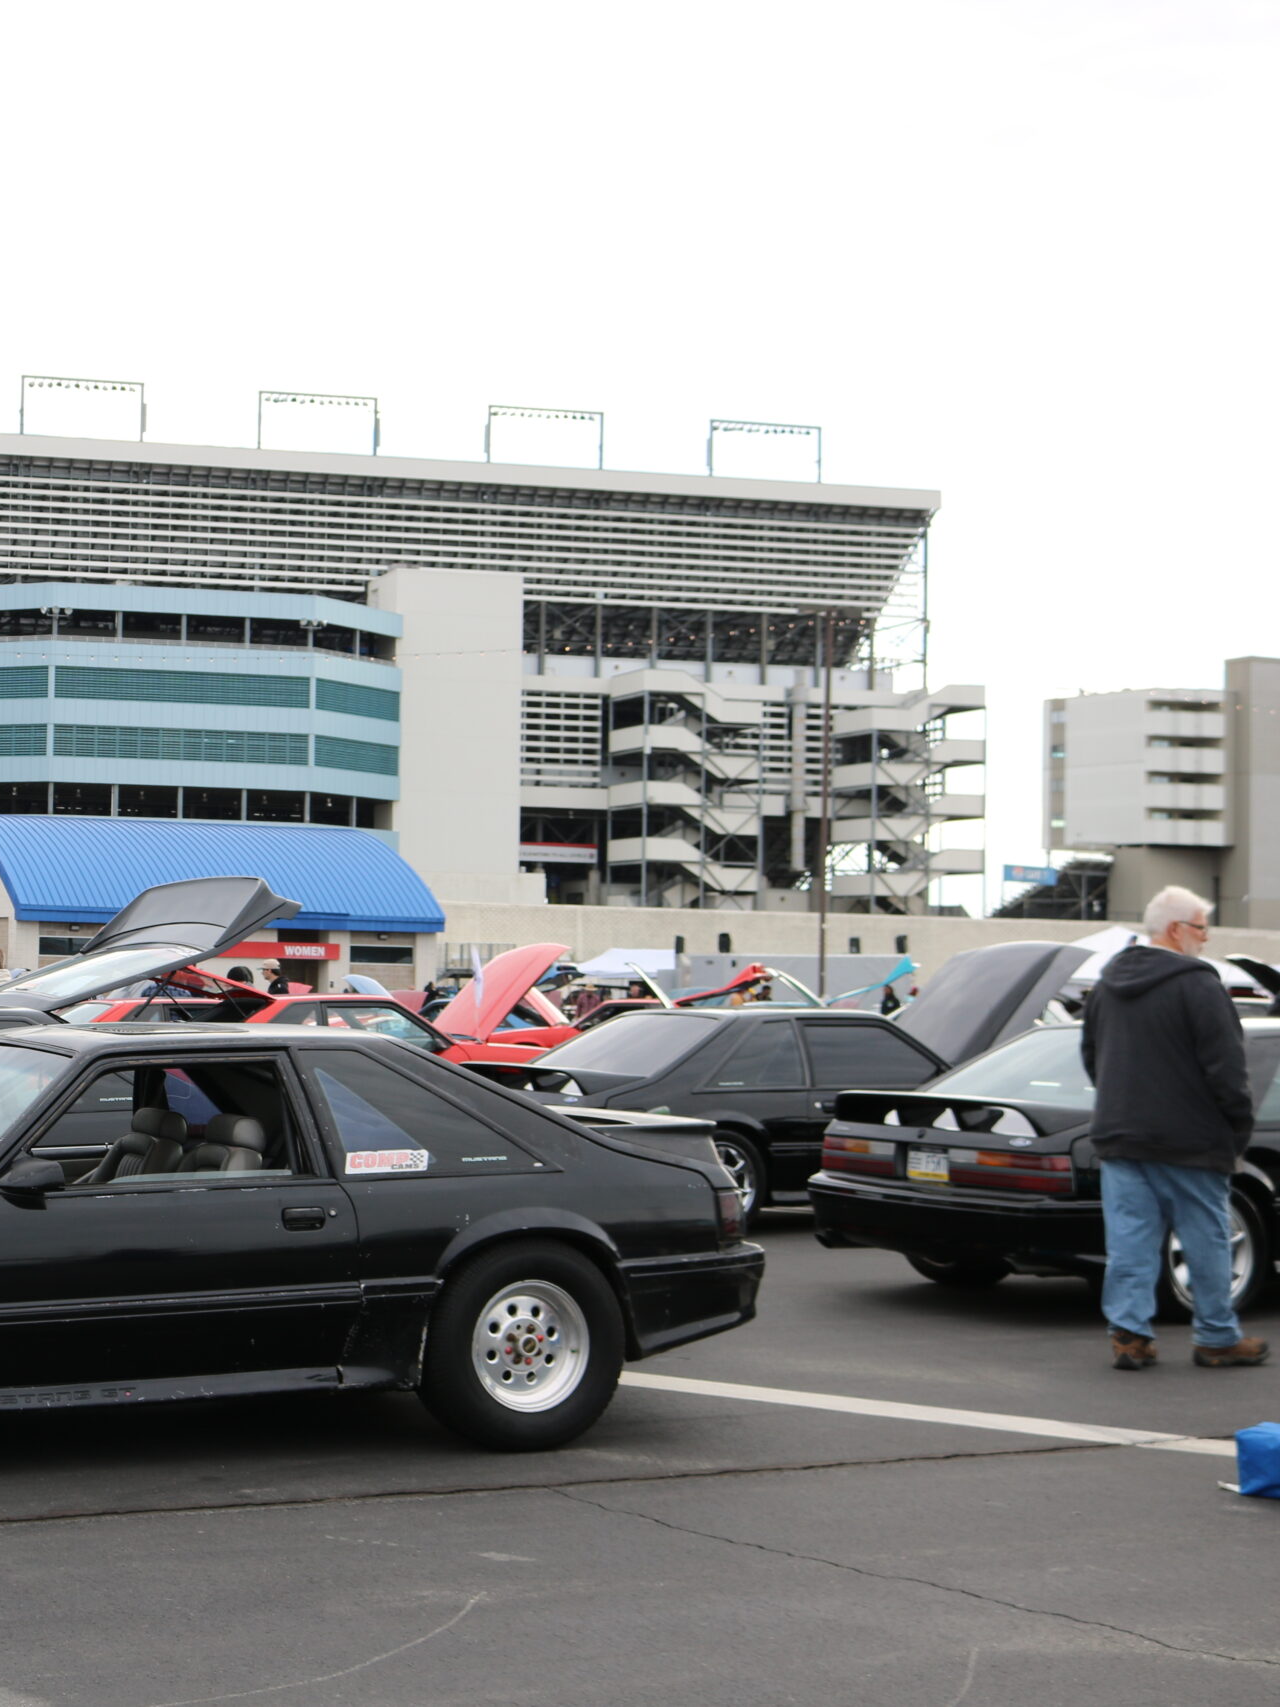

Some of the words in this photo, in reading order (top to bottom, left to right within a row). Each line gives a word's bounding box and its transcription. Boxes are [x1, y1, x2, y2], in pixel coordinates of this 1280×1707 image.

[283, 944, 325, 957] WOMEN
[350, 1152, 410, 1169] COMP
[391, 1163, 420, 1171] CAMS
